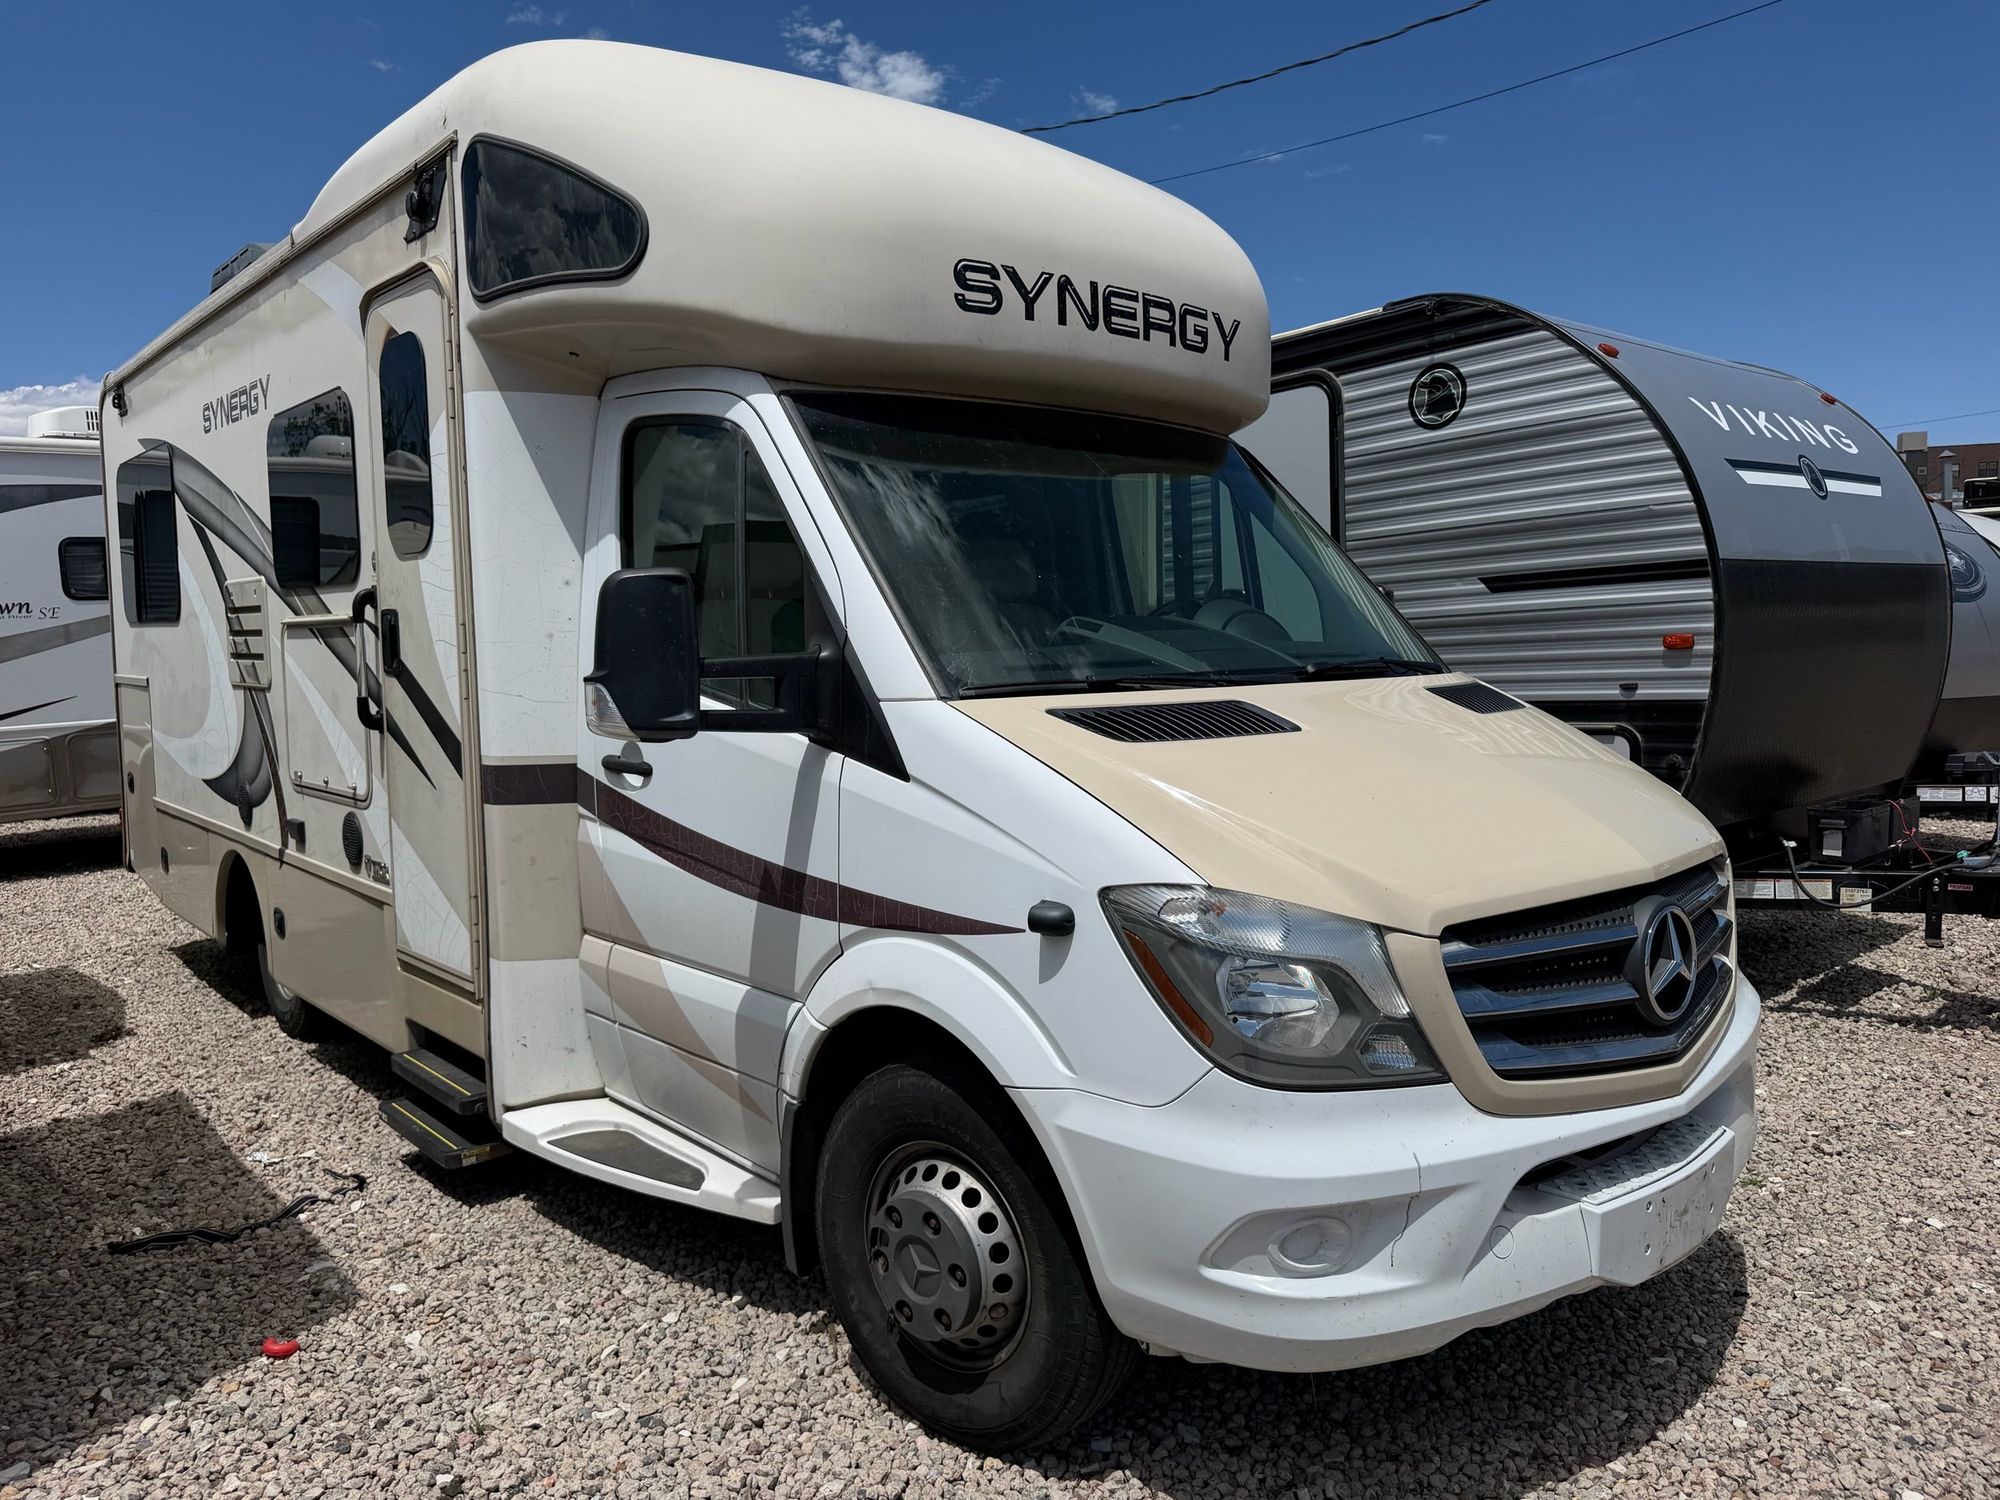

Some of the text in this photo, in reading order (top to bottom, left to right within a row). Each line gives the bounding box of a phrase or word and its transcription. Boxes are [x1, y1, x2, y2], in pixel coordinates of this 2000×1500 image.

[953, 258, 1241, 361] SYNERGY
[203, 374, 270, 434] SYNERGY
[1688, 396, 1859, 455] VIKING
[38, 606, 61, 620] SE
